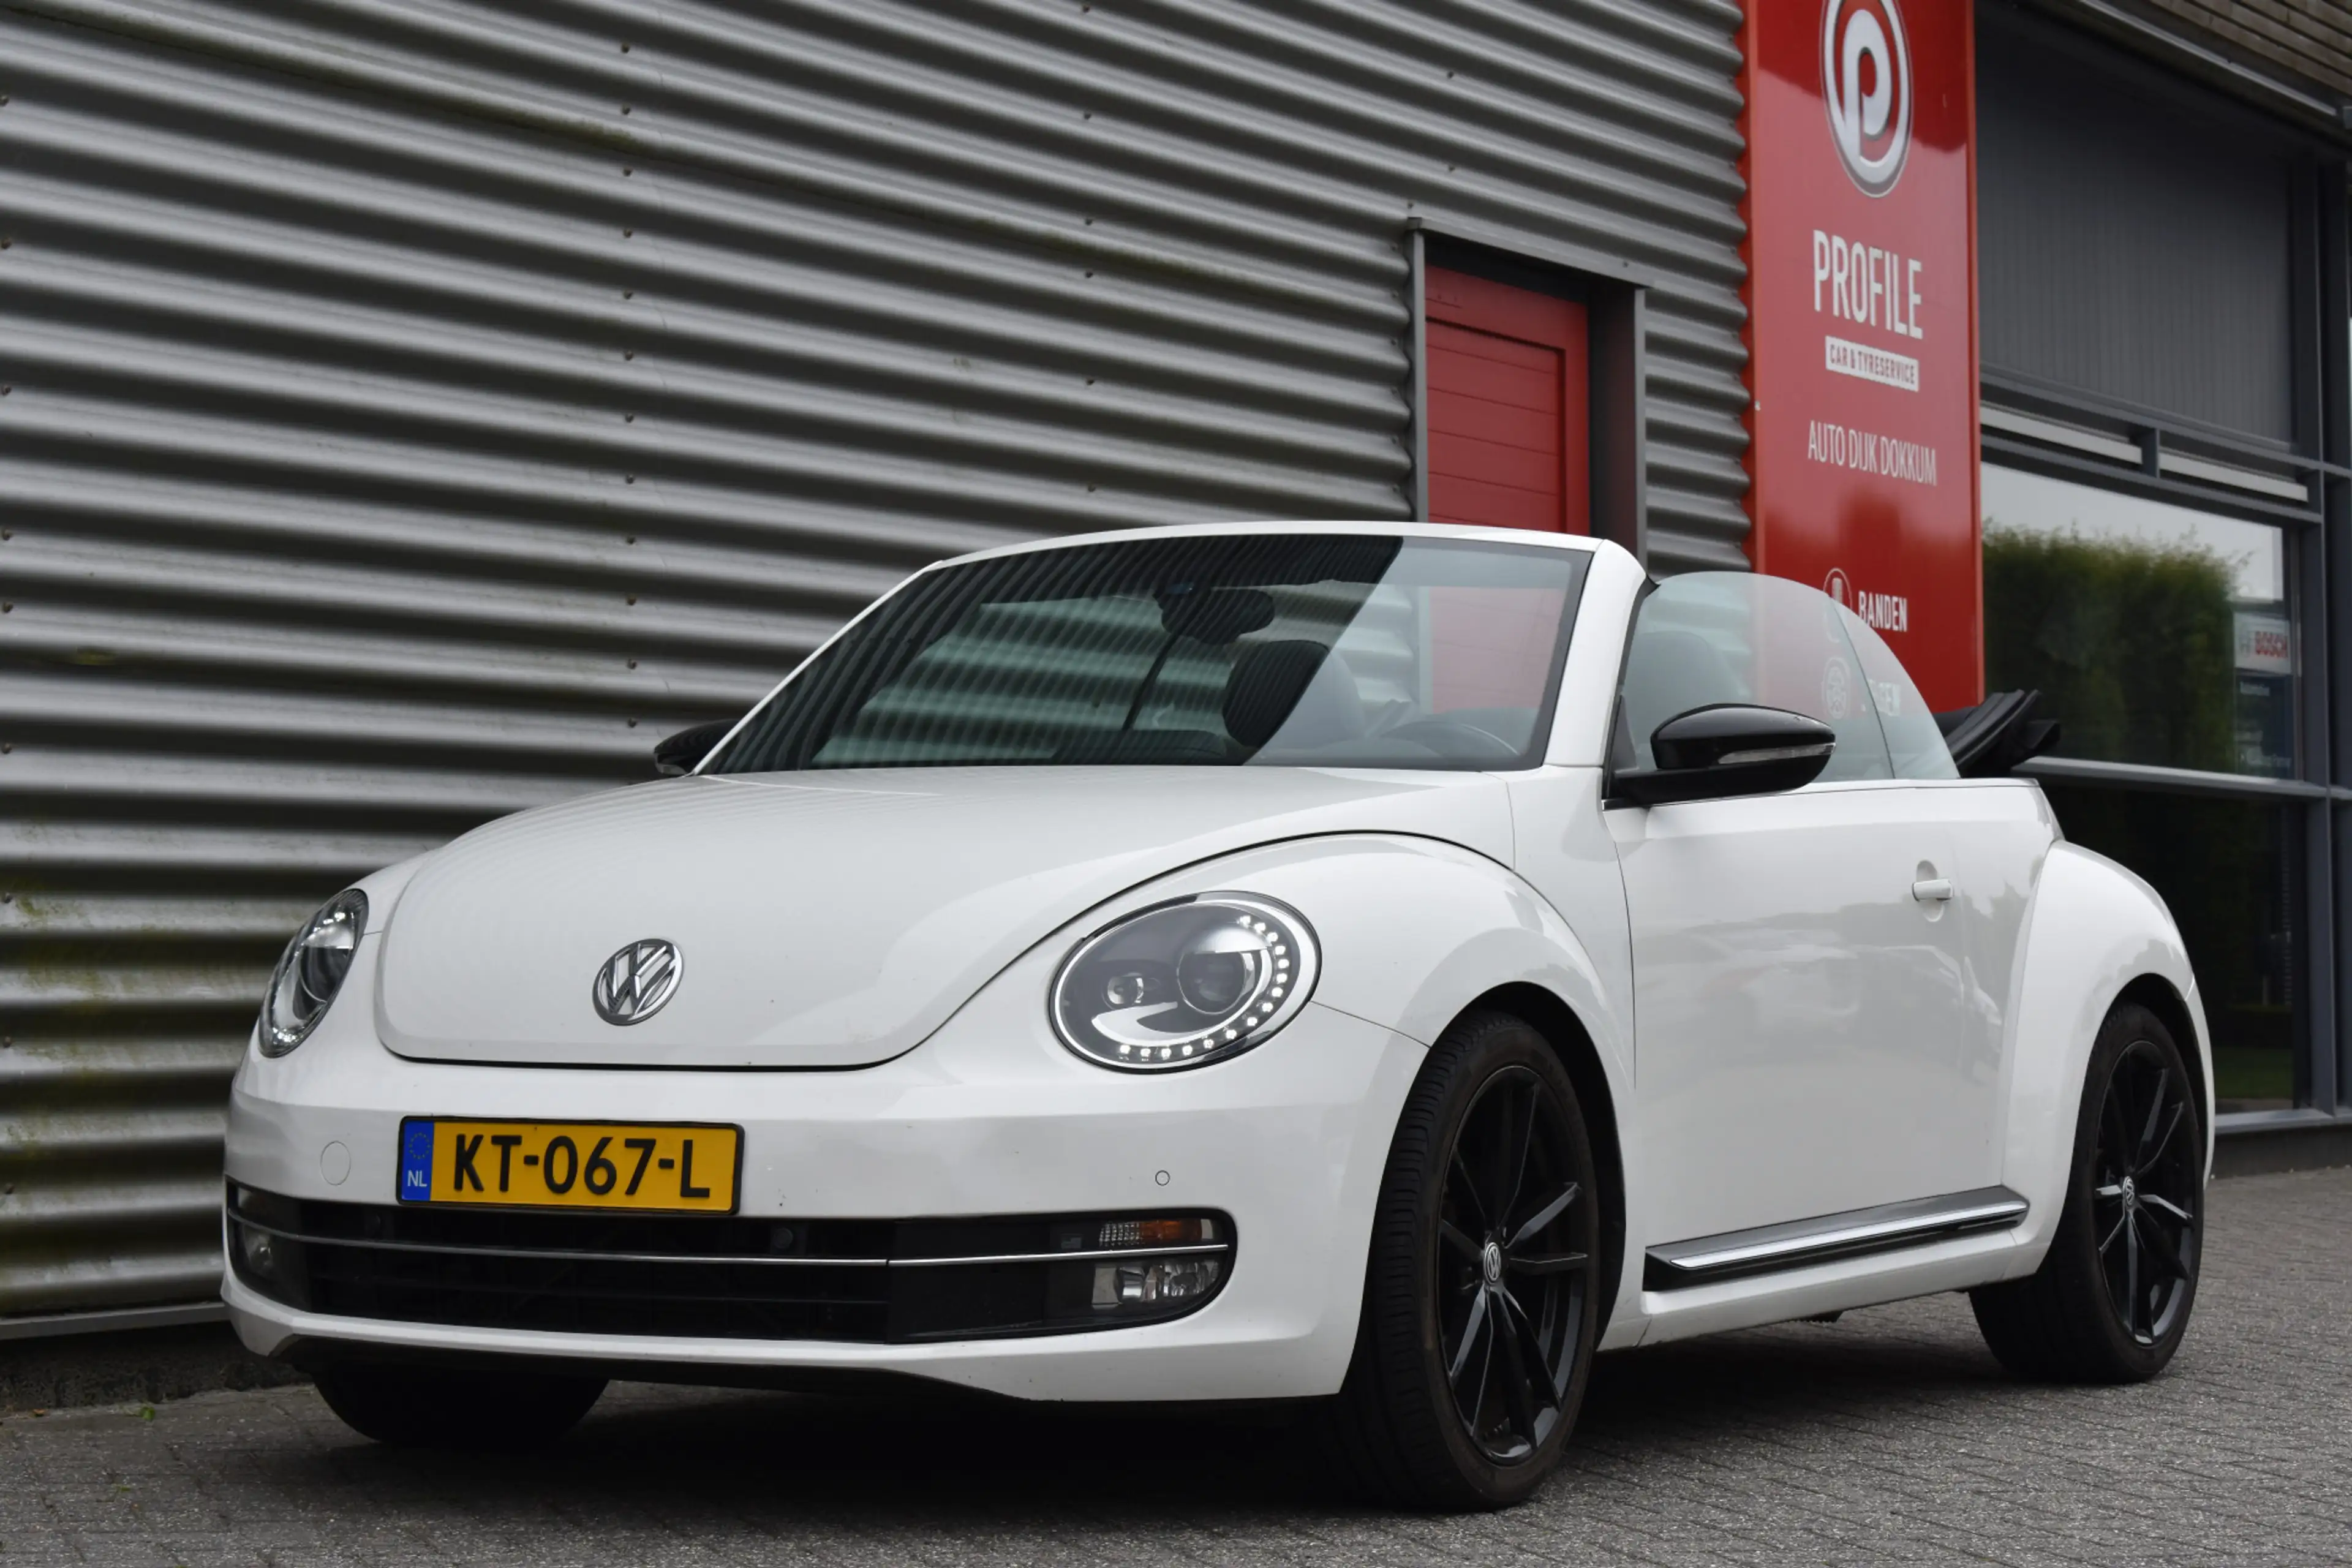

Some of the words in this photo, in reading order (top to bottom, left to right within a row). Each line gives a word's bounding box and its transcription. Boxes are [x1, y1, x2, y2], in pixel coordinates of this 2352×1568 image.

[1814, 229, 1923, 339] PROFILE
[1830, 344, 1848, 366] CAR
[1858, 350, 1915, 385] TYRESERVICE
[1808, 420, 1845, 466] AUTO
[1849, 428, 1878, 473] DIJK
[1880, 435, 1937, 486] DOKKUM
[1858, 590, 1907, 633] BANDEN
[407, 1170, 427, 1188] NL
[453, 1133, 710, 1199] KT-067-L
